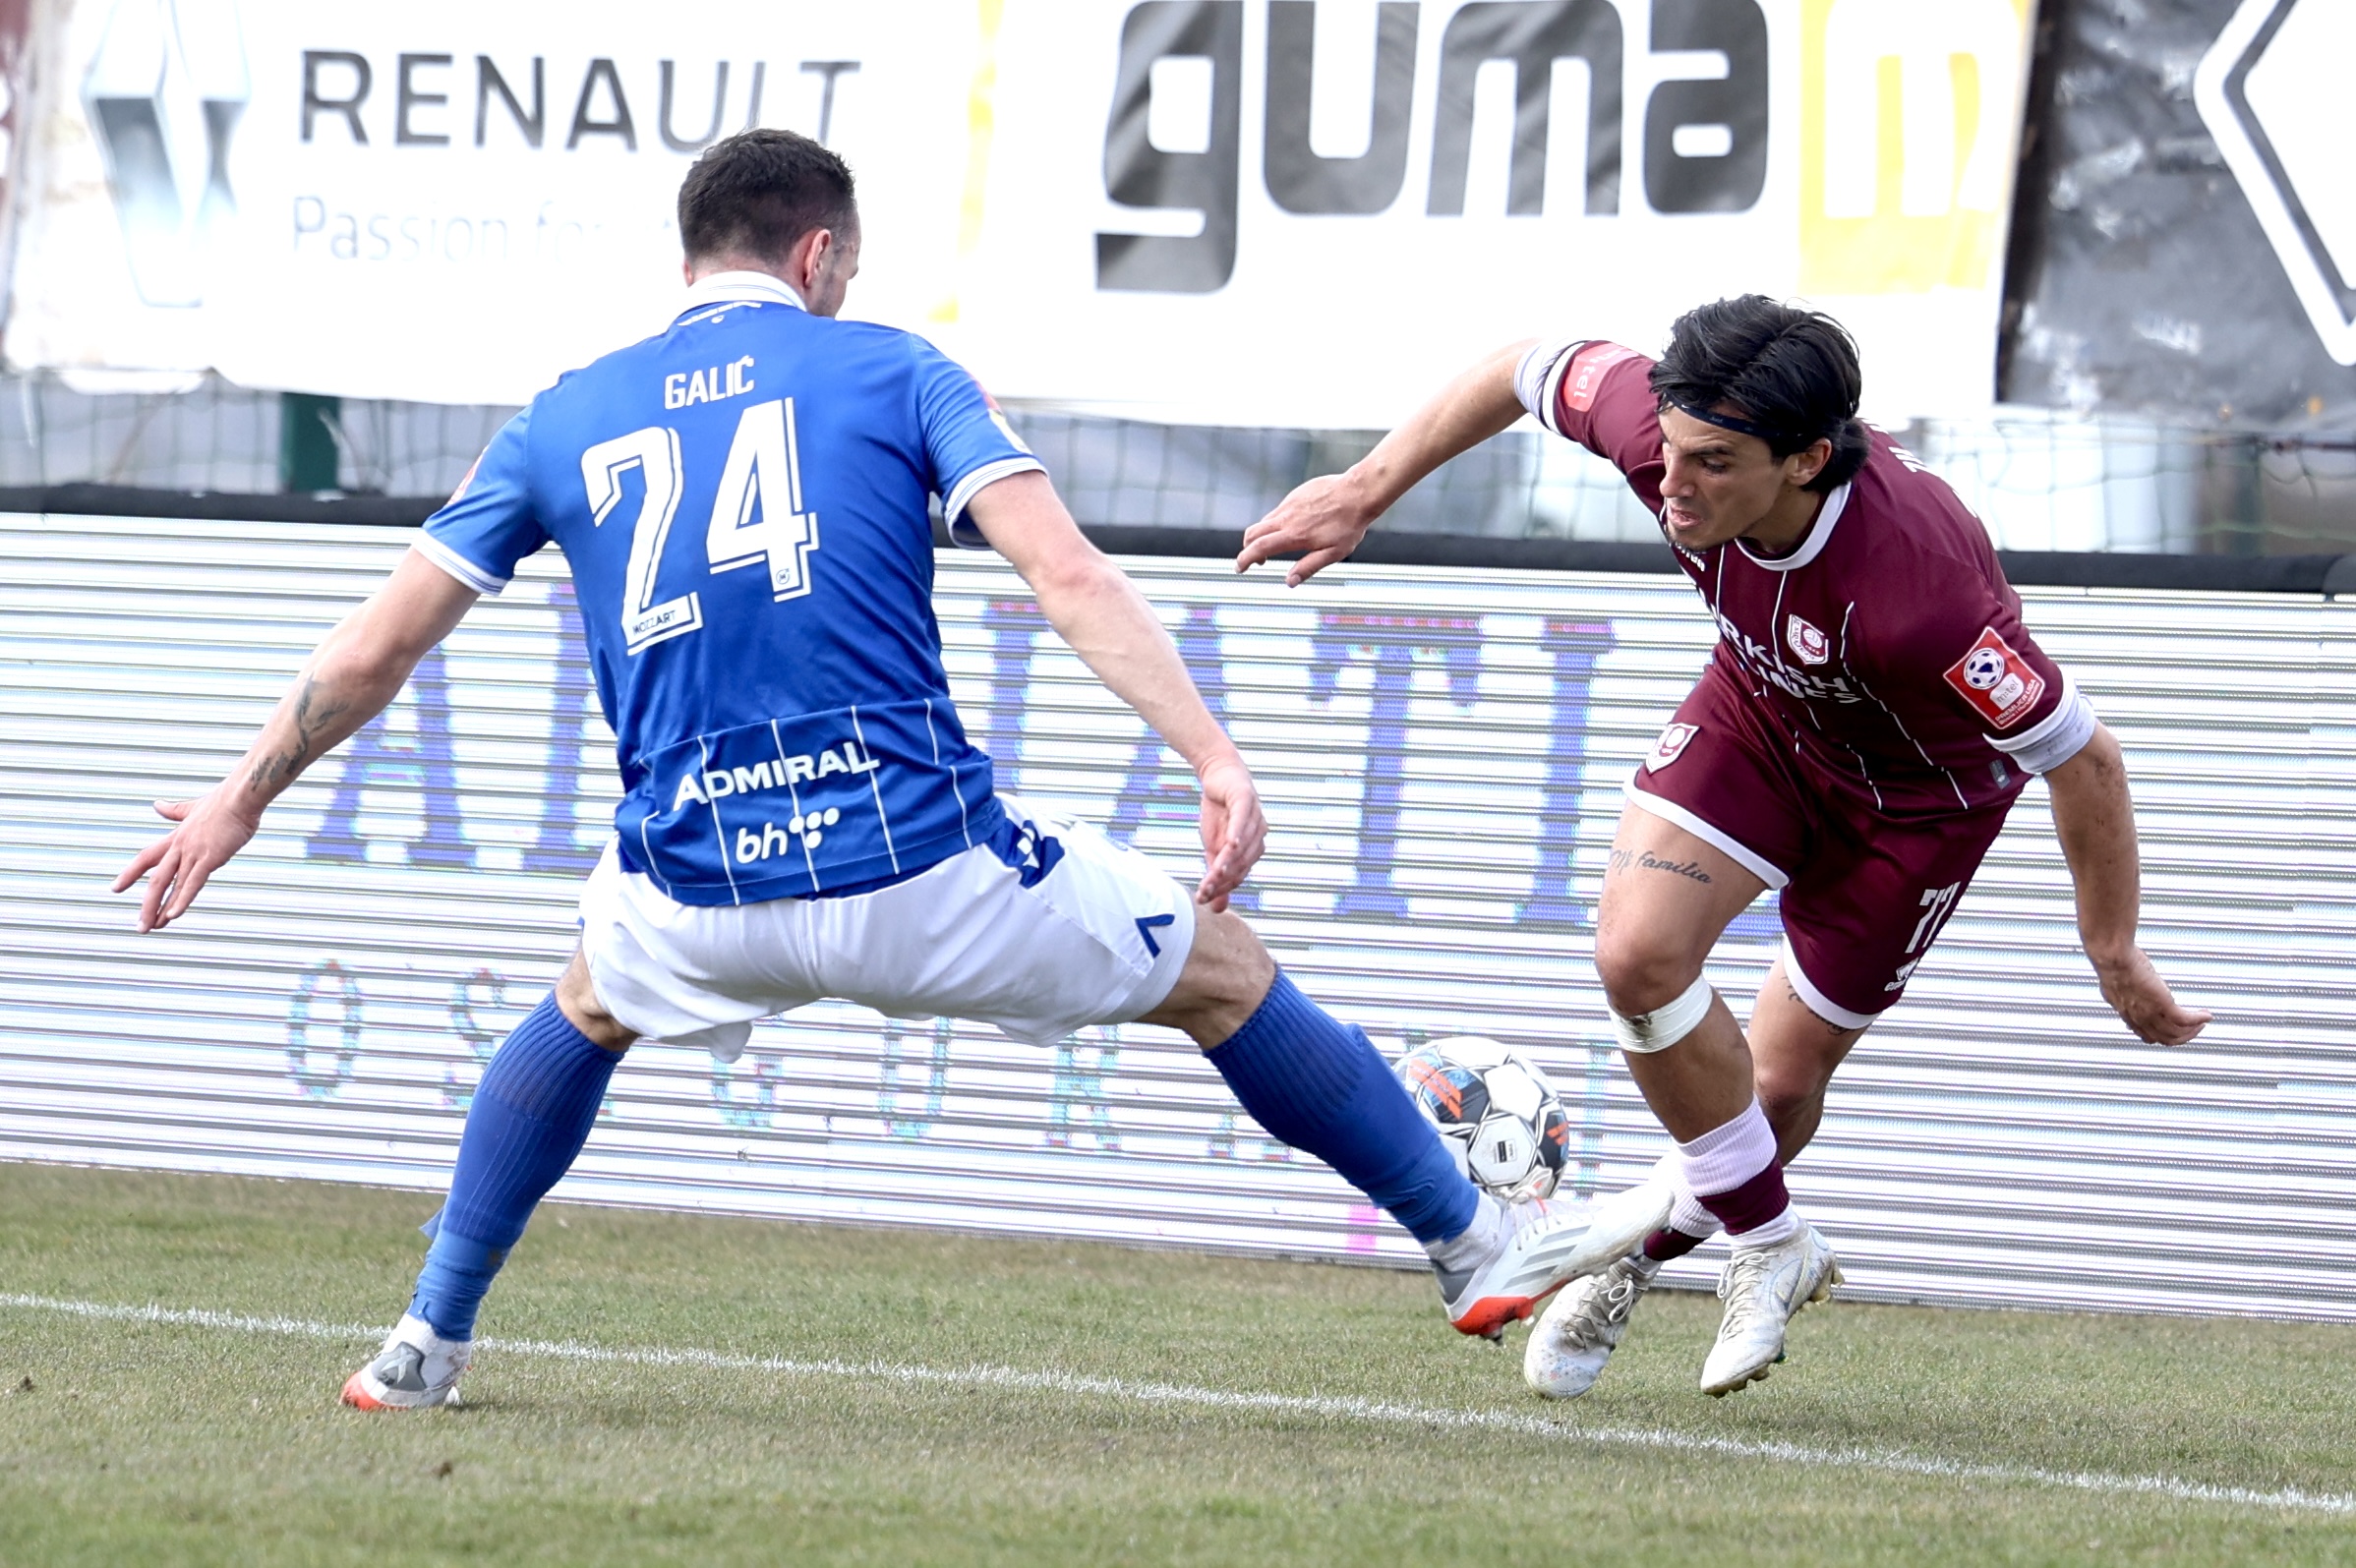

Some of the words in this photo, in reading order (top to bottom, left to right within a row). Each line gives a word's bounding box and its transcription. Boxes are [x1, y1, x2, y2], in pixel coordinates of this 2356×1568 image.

[1095, 0, 1770, 293] guma
[293, 195, 509, 262] Passion
[665, 355, 755, 410] GALIĆ
[581, 397, 823, 656] 24
[632, 610, 676, 636] MOZZART
[1996, 679, 2019, 703] m:tel
[673, 741, 881, 812] ADMIRAL
[736, 822, 789, 864] bh
[1634, 850, 1712, 883] Familia
